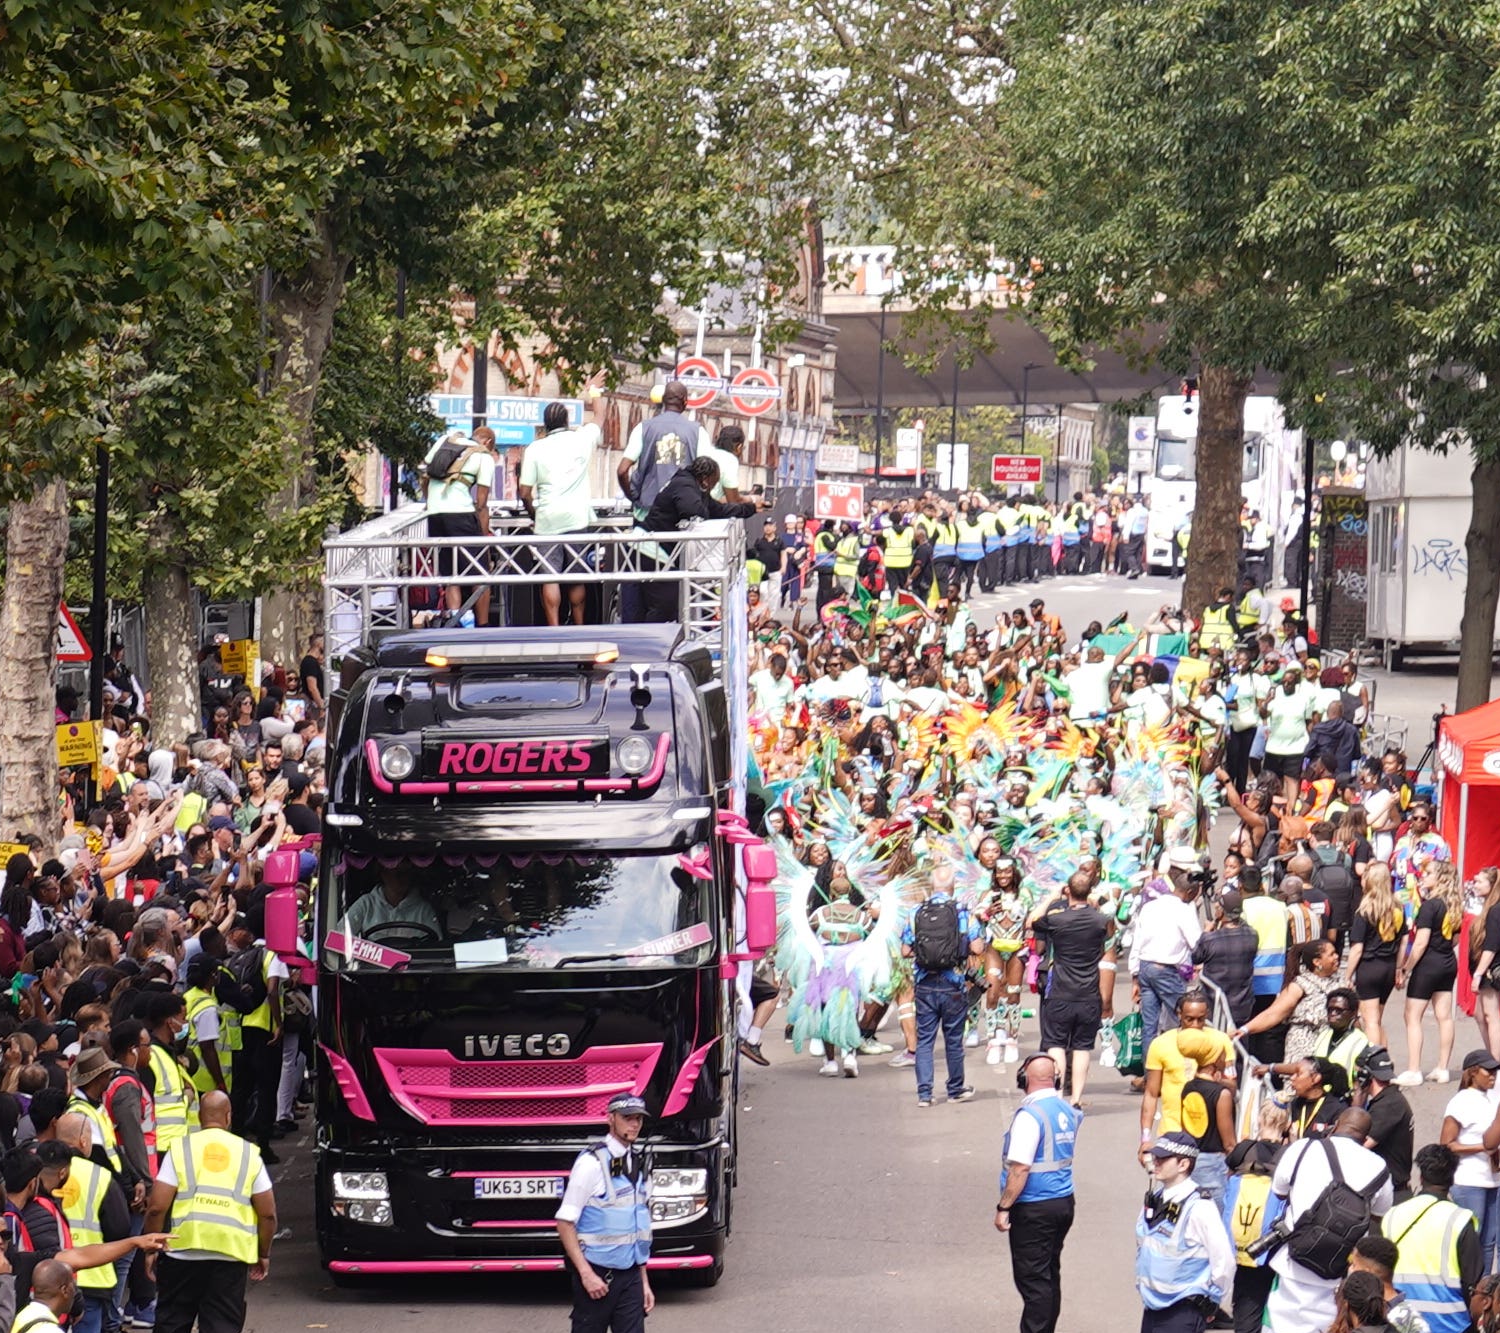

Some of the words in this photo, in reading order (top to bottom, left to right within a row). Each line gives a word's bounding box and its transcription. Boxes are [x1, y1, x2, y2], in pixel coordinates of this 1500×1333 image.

[501, 401, 539, 421] STORE
[828, 485, 851, 498] STOP
[60, 741, 92, 753] WARNING
[438, 740, 592, 775] ROGERS
[351, 940, 383, 963] EMMA
[643, 931, 693, 956] SUMMER
[464, 1033, 571, 1057] IVECO
[482, 1179, 523, 1196] UK63
[526, 1179, 557, 1196] SRT
[195, 1196, 231, 1208] TEWARD
